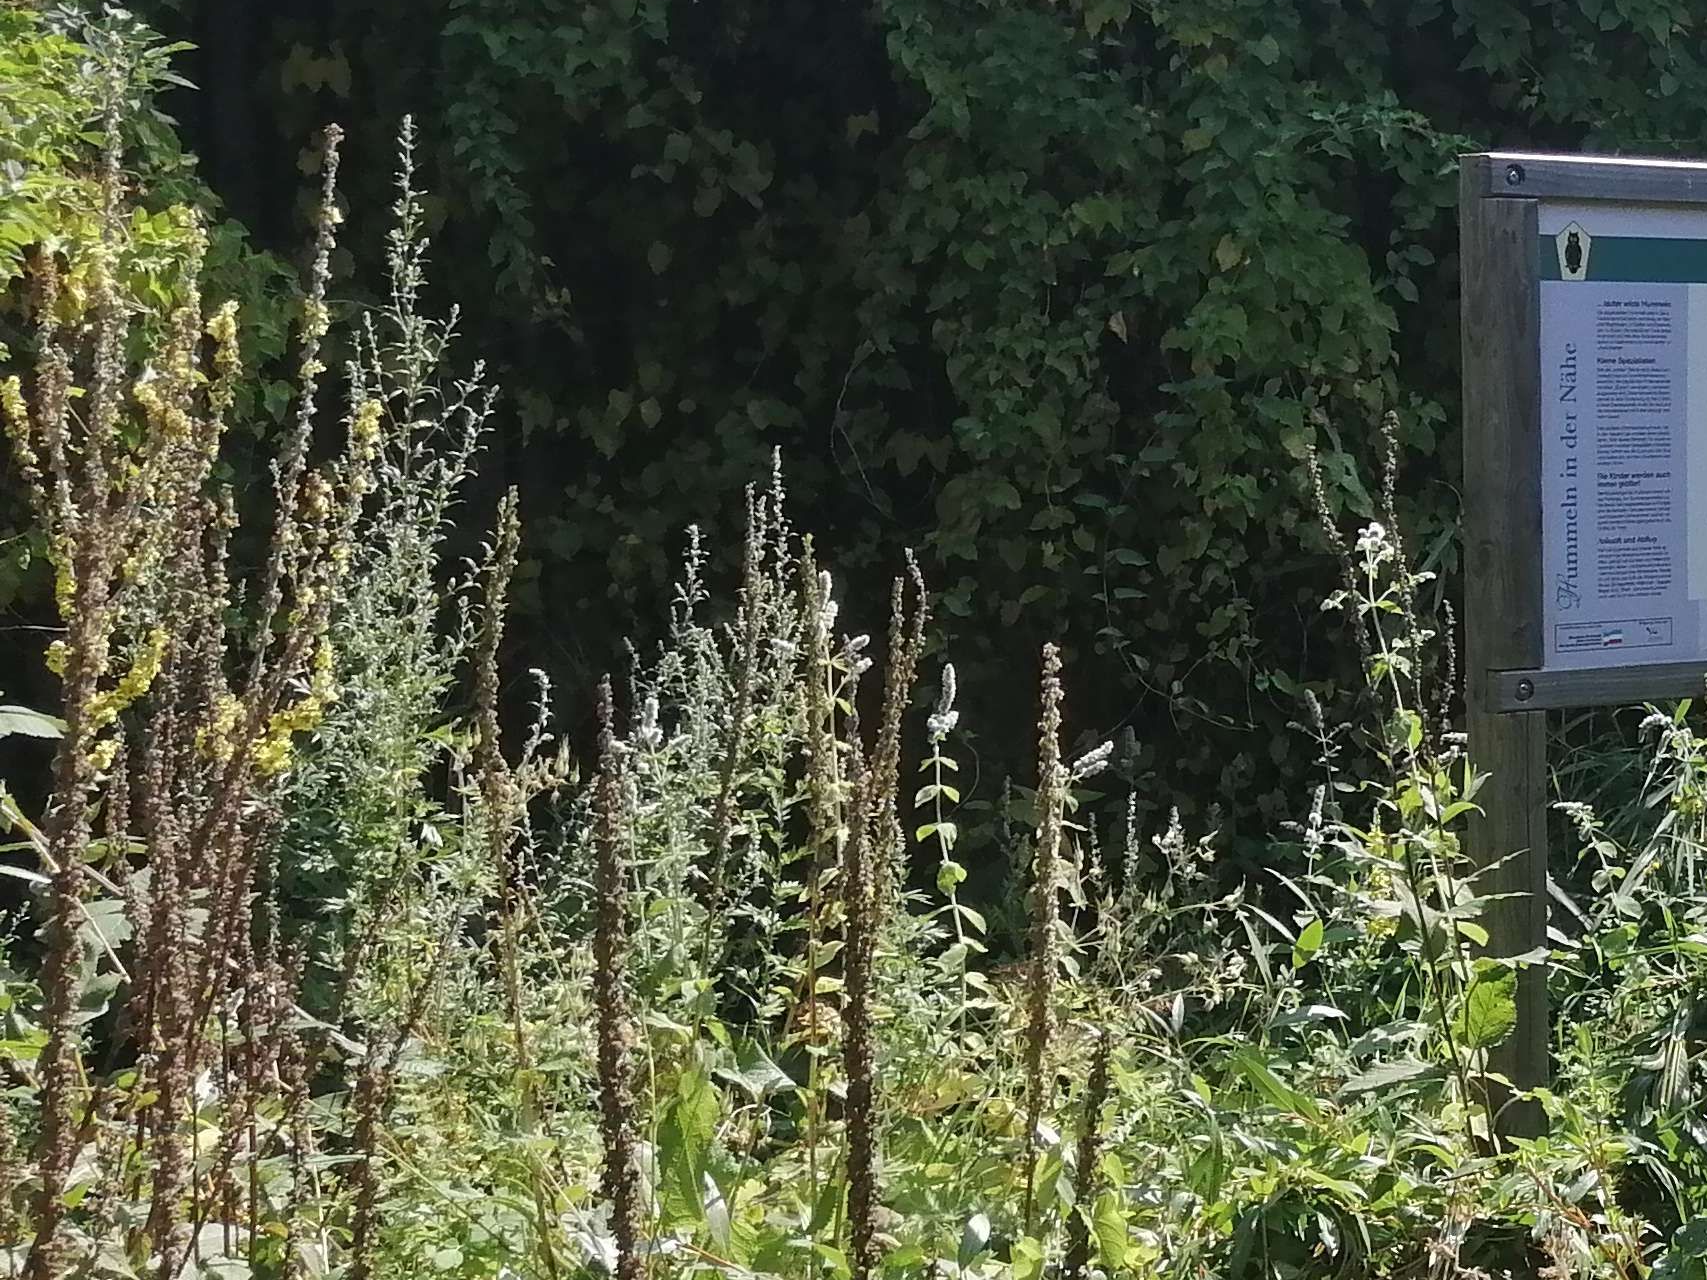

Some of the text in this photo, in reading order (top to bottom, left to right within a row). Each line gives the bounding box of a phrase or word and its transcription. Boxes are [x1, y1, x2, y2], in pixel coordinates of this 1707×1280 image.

[1556, 342, 1580, 611] Hummeln in der Nähe
